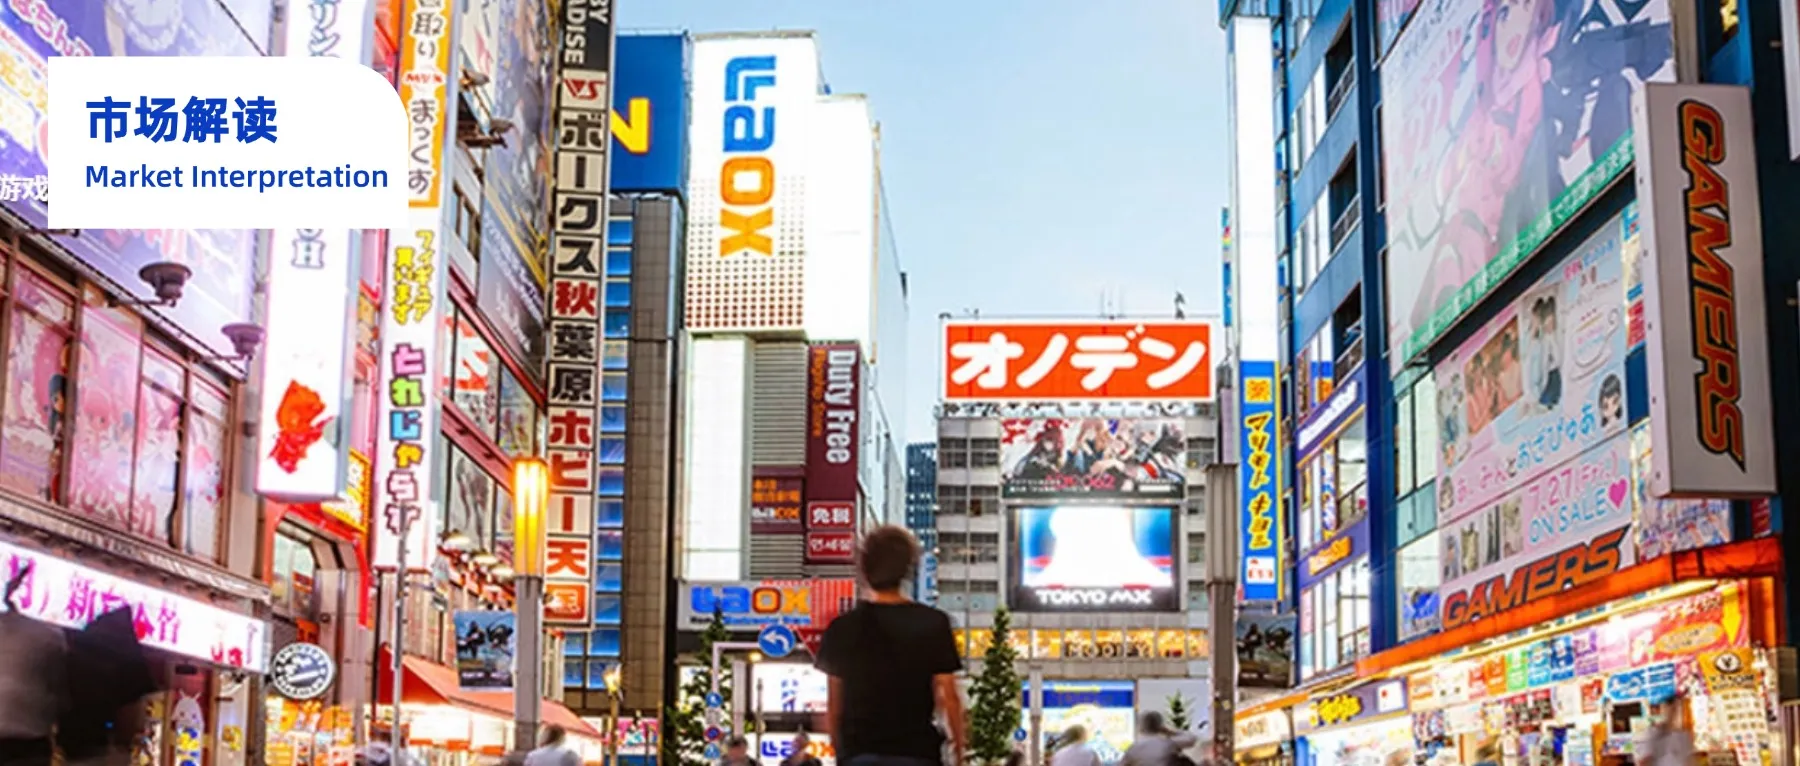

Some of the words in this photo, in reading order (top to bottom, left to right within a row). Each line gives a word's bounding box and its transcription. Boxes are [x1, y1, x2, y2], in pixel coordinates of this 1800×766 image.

[413, 0, 444, 60] 取り
[1677, 97, 1747, 474] GAMERS
[825, 350, 858, 405] Duty
[950, 325, 1206, 391] オノデン
[825, 409, 856, 464] Free
[1558, 487, 1606, 532] SALE
[1035, 589, 1107, 605] TOKYO
[1109, 589, 1152, 605] MX
[1441, 524, 1633, 632] GAMERS
